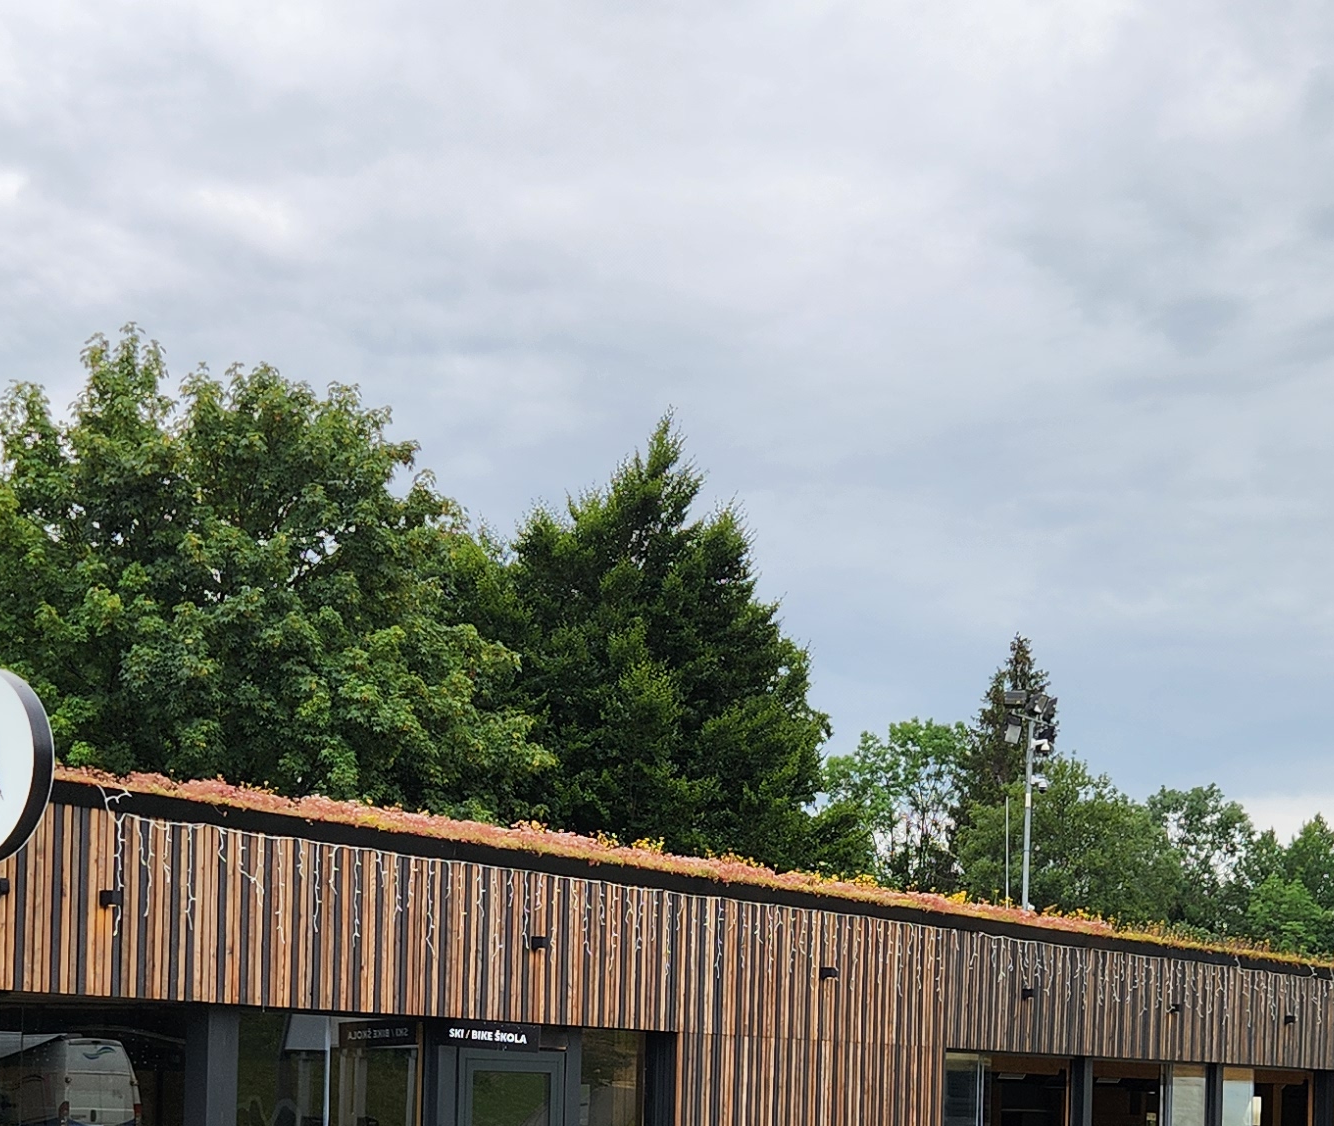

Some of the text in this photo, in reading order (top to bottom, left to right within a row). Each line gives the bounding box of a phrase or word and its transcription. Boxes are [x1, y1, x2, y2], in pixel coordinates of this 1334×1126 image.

[449, 1027, 464, 1039] SKI
[471, 1029, 493, 1042] BIKE
[494, 1029, 528, 1045] ŠKOLA
